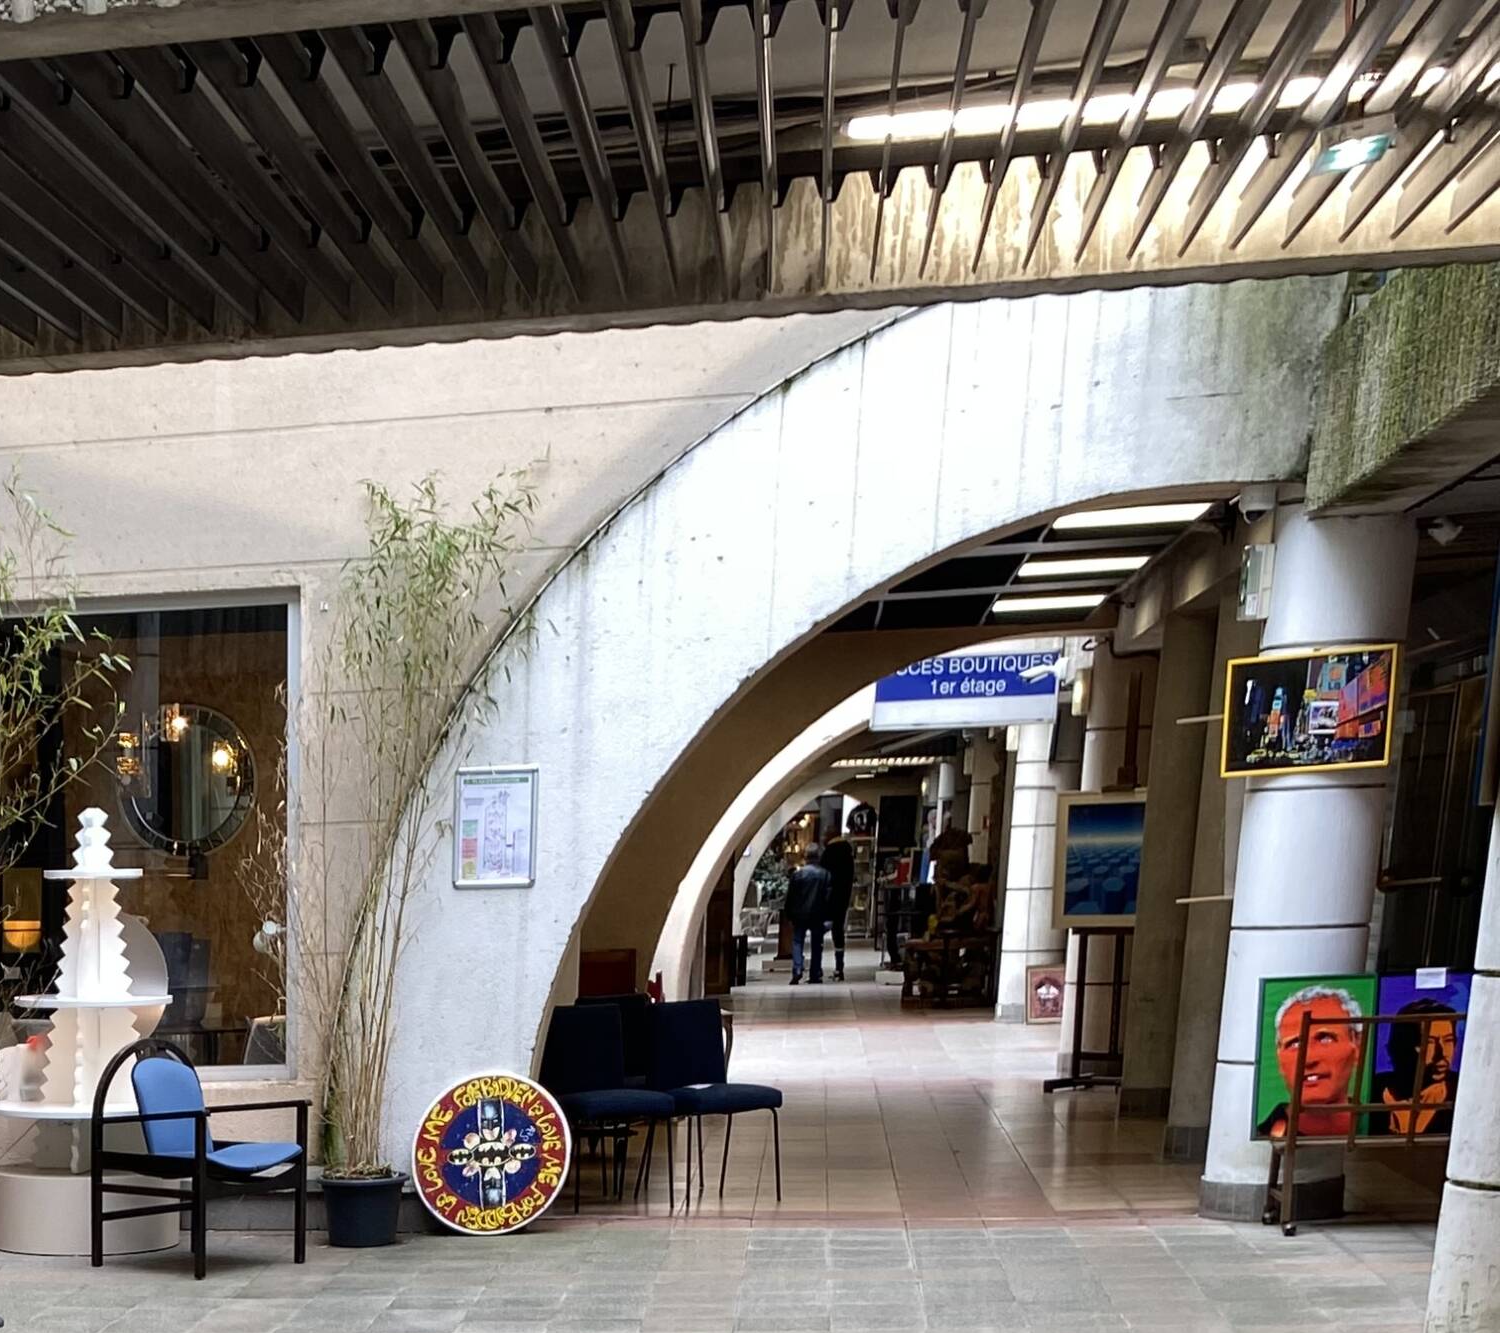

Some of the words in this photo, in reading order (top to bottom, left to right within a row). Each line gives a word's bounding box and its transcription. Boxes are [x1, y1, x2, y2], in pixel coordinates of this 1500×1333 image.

[949, 654, 1053, 674] BOUTIQUES
[930, 679, 957, 695] 1er
[960, 677, 1006, 695] étage
[423, 1104, 454, 1143] ME
[538, 1153, 562, 1187] ME
